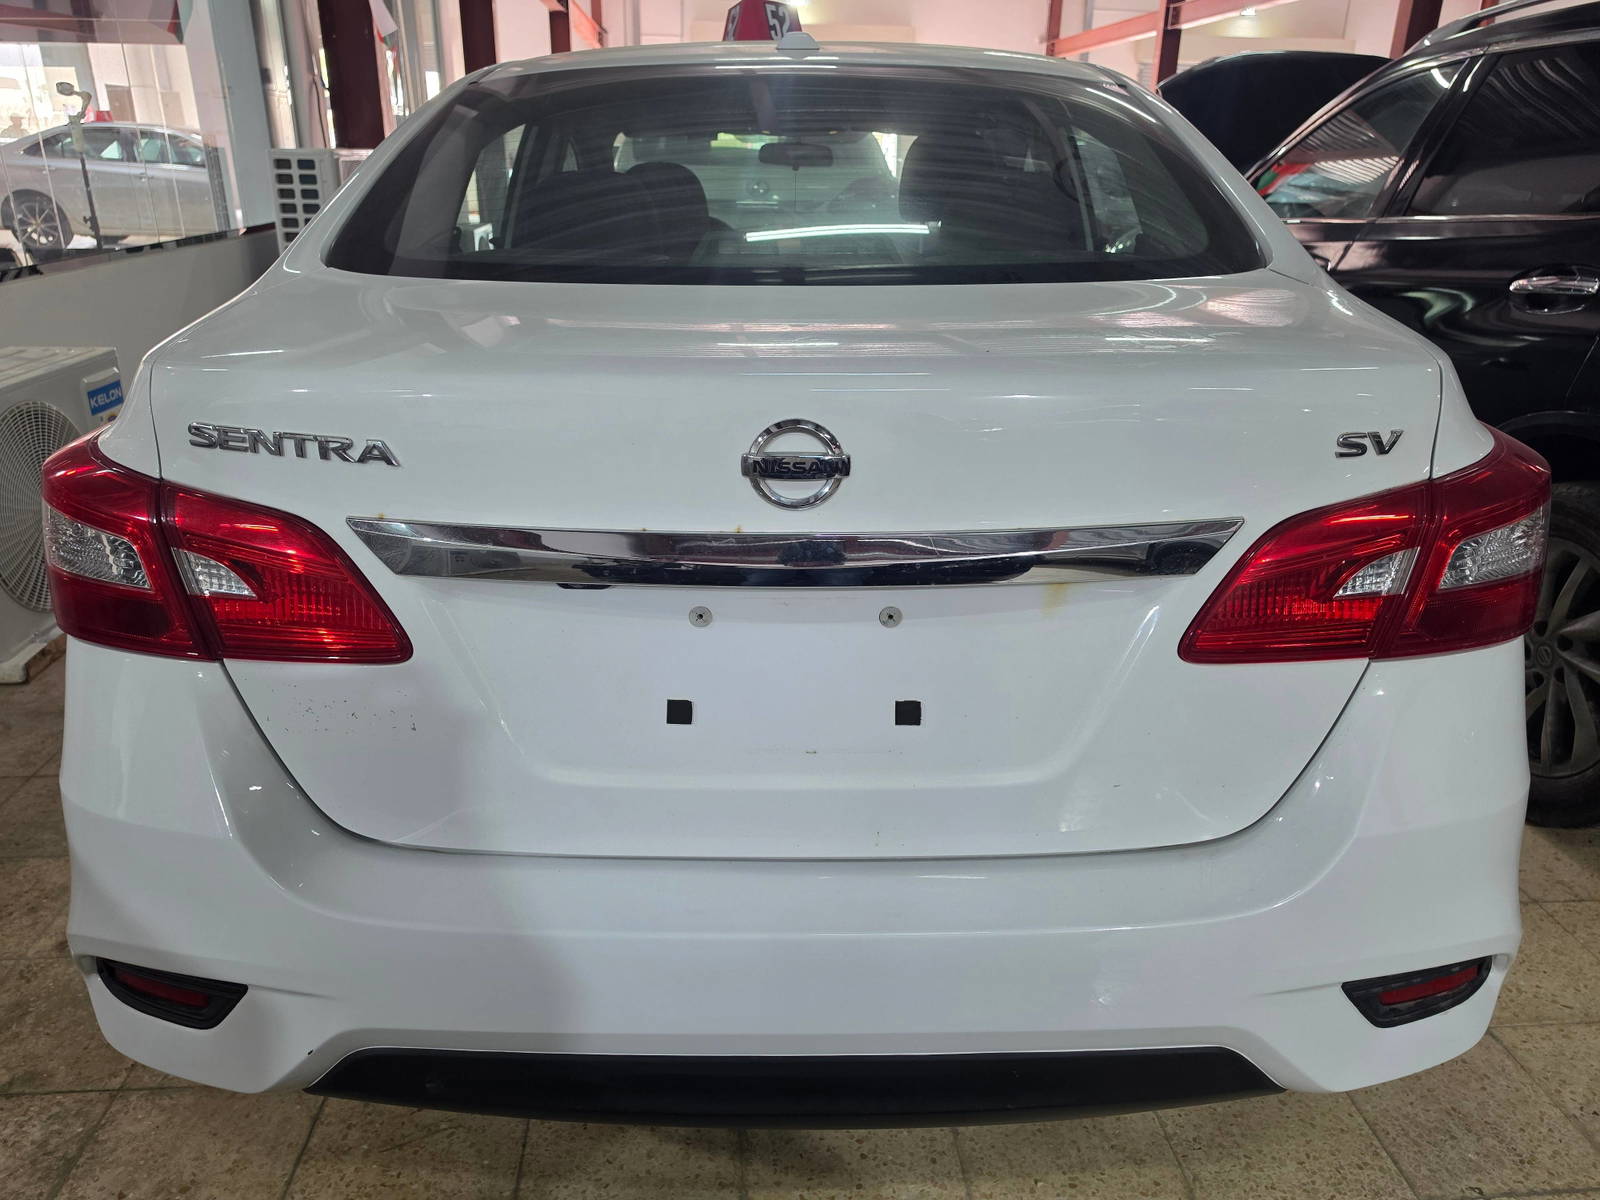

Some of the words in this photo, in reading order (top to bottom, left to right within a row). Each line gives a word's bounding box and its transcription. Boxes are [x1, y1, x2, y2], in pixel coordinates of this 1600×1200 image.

[765, 3, 791, 40] 52
[89, 386, 122, 409] KELON
[188, 421, 401, 467] SENTRA
[1335, 429, 1404, 458] SV
[752, 460, 841, 476] NISSAN
